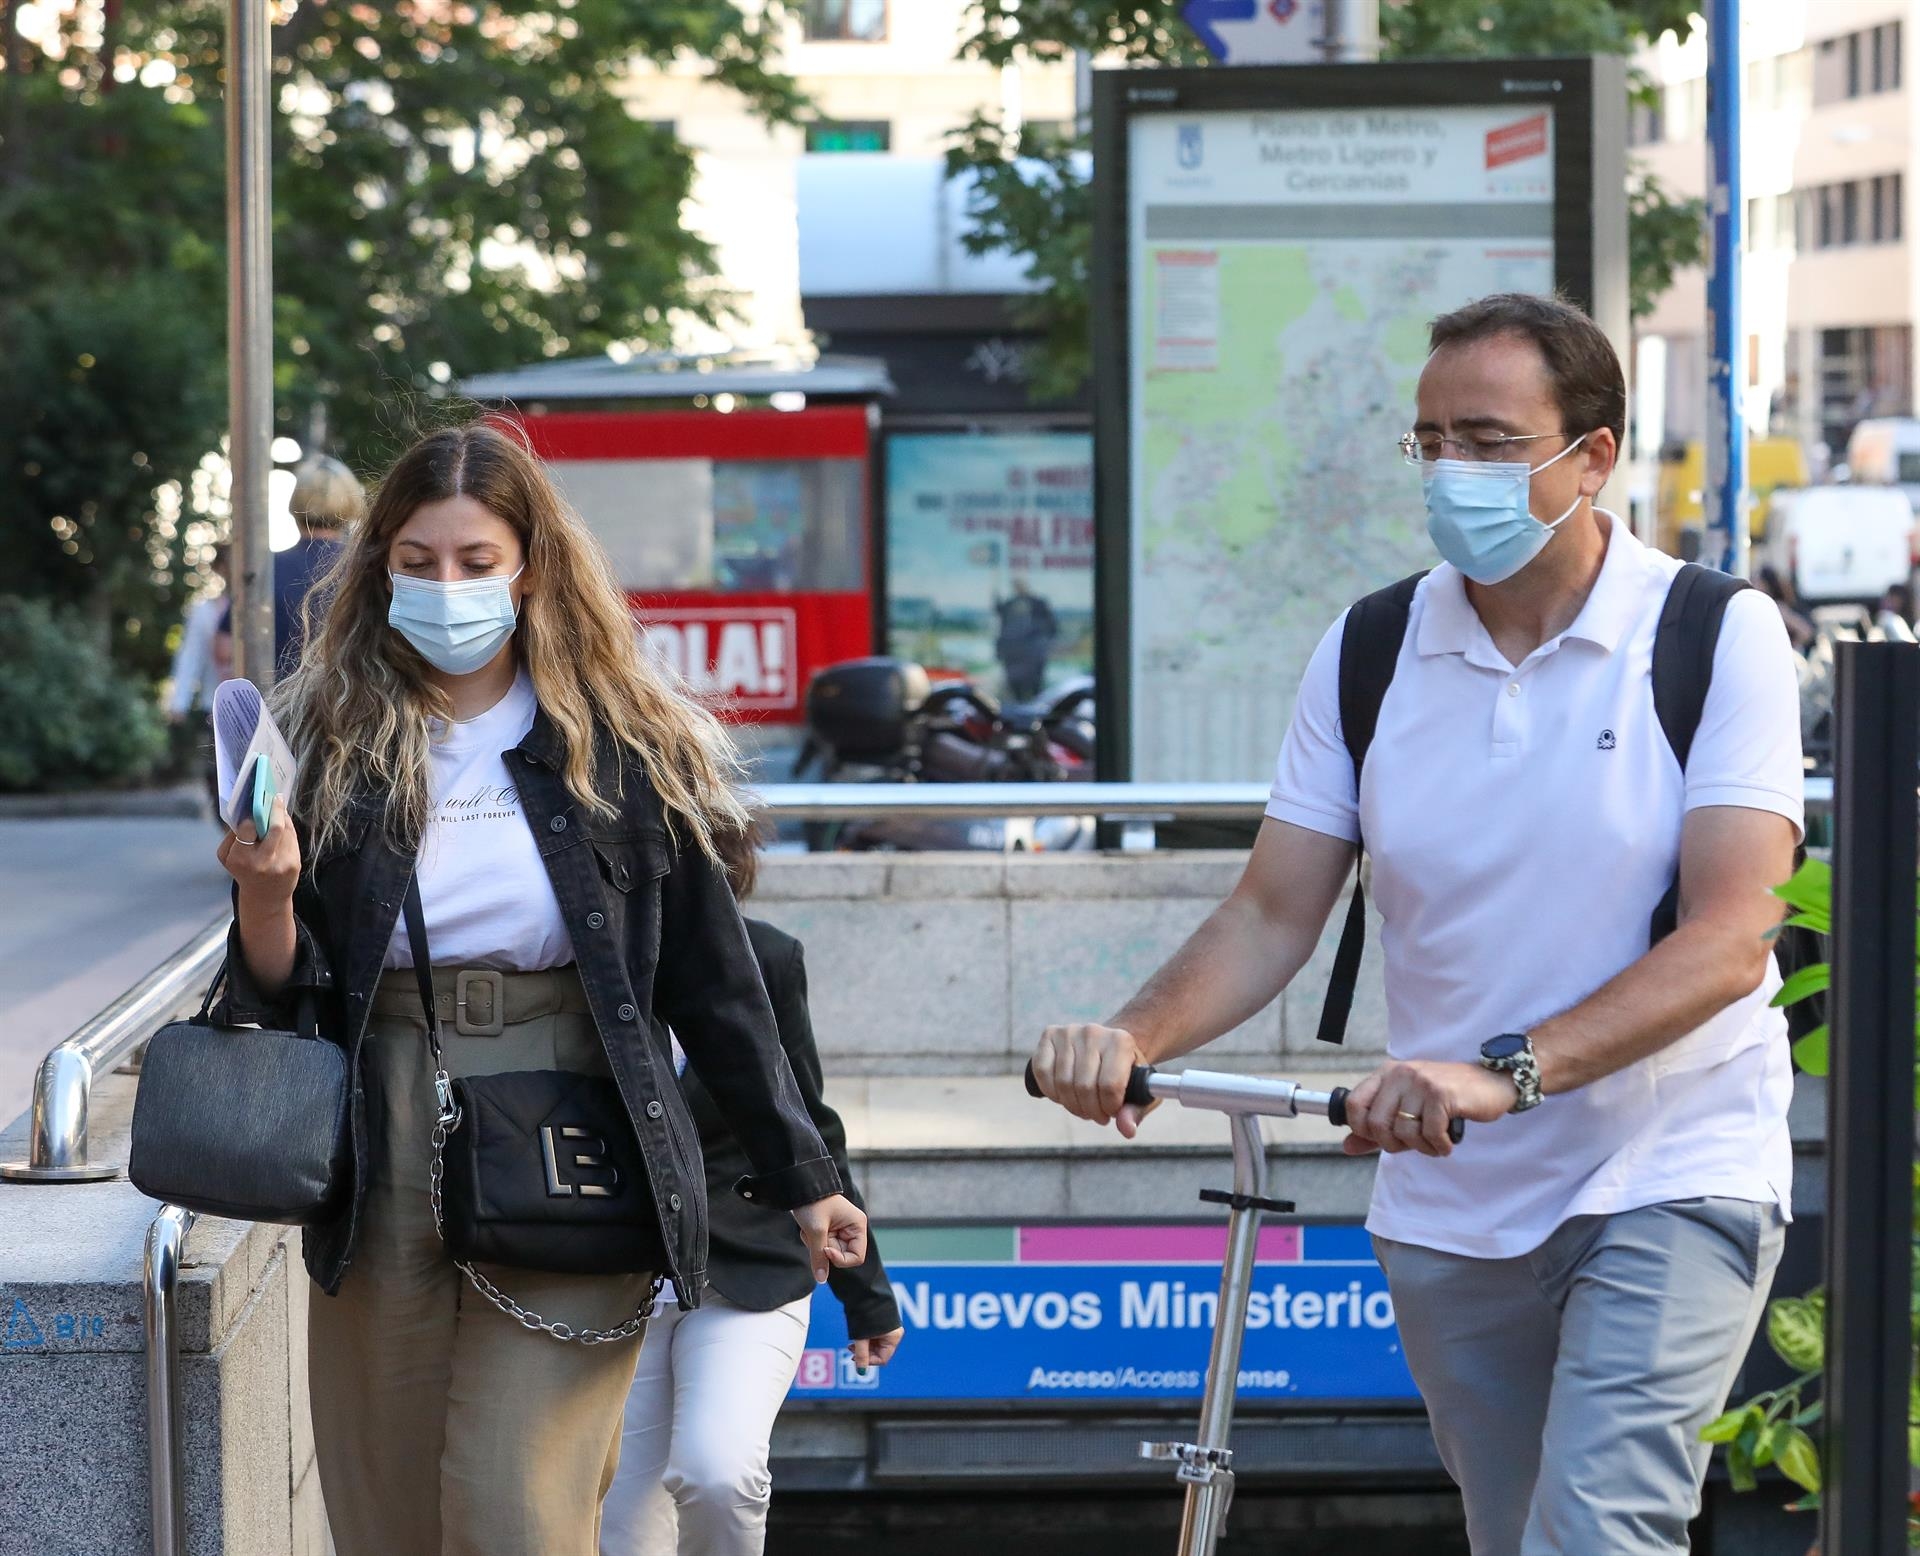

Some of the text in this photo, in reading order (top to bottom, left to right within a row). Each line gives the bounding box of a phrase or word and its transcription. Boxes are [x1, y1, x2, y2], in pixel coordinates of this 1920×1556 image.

[1327, 114, 1357, 137] de
[1259, 144, 1438, 168] Metro Ligero y
[641, 622, 783, 694] OLA!
[444, 784, 491, 810] will
[440, 816, 459, 824] WILL
[460, 813, 480, 822] LAST
[482, 810, 517, 820] FOREVER
[892, 1280, 1396, 1331] Nuevos Minsterio
[804, 1354, 828, 1383] 8
